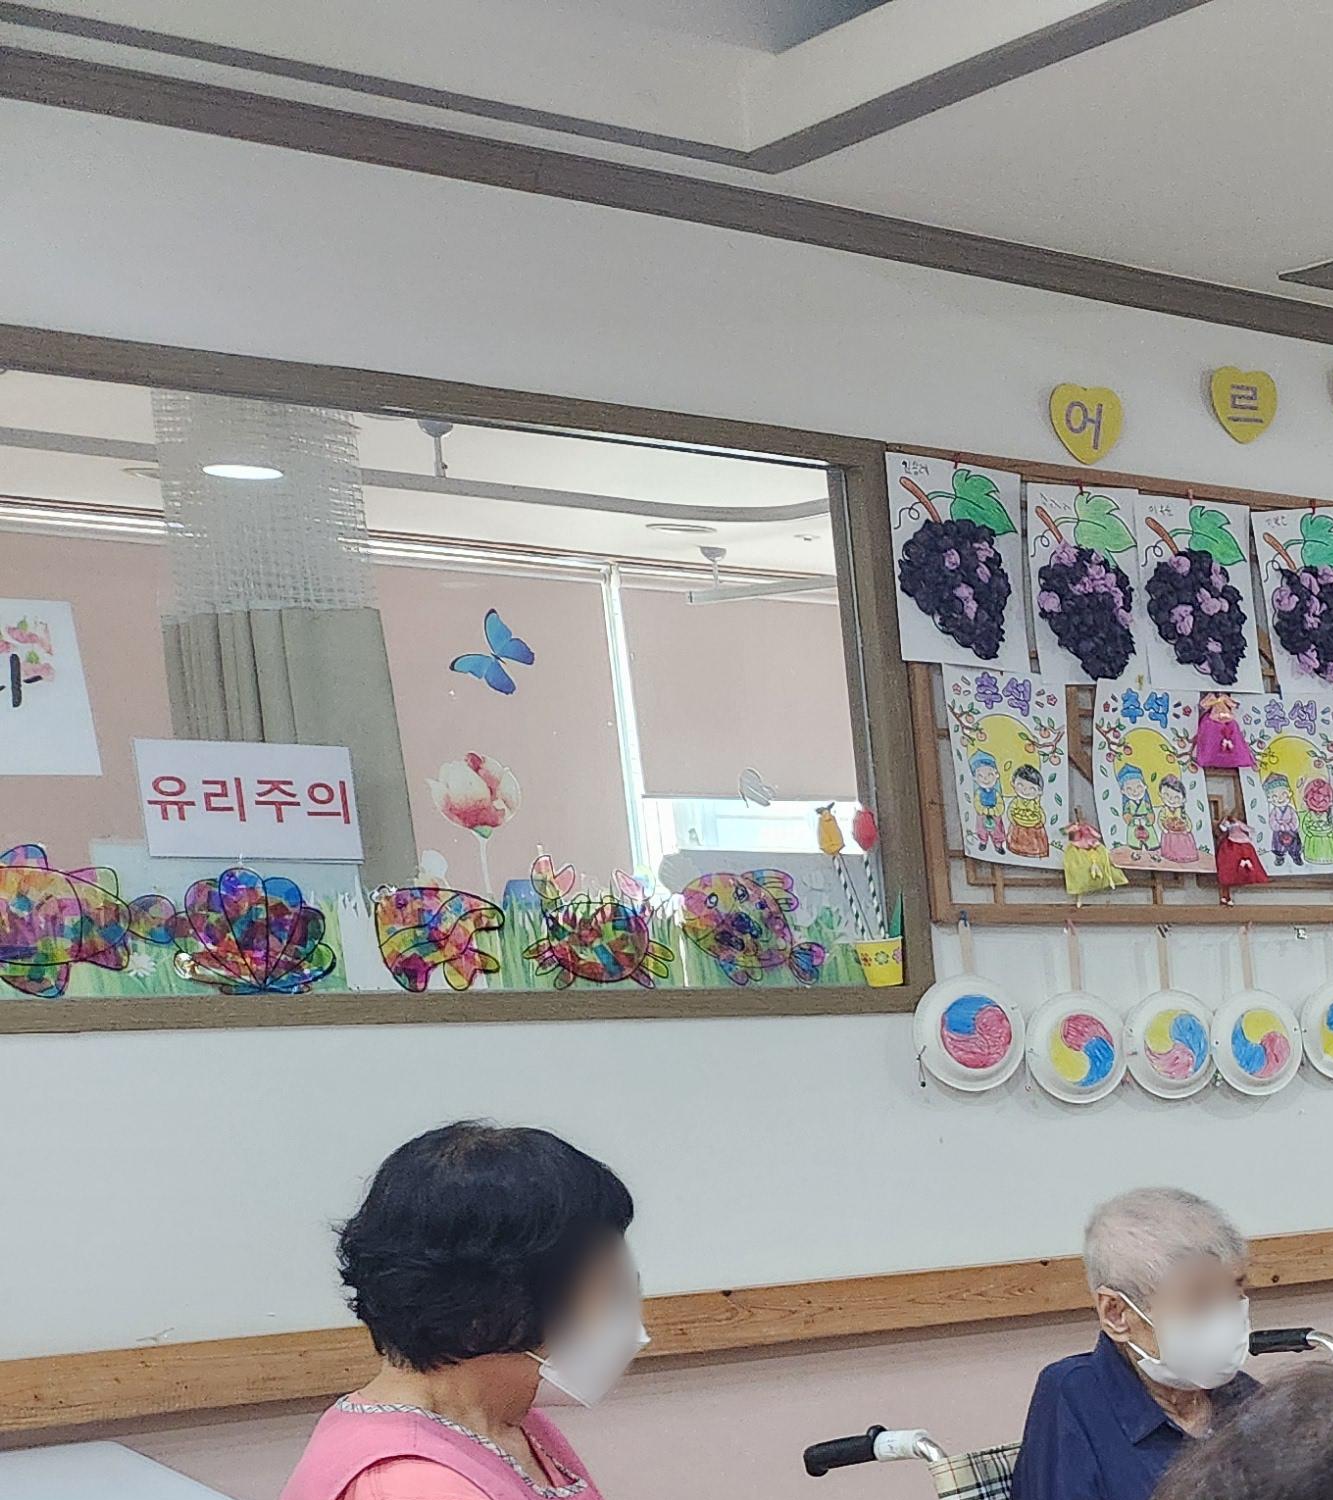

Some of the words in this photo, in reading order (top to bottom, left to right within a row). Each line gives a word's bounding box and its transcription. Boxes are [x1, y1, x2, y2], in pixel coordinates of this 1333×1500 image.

[974, 671, 1032, 717] 추석
[1120, 687, 1169, 729] 추석
[1264, 699, 1318, 735] 추석
[146, 776, 351, 825] 유리주의
